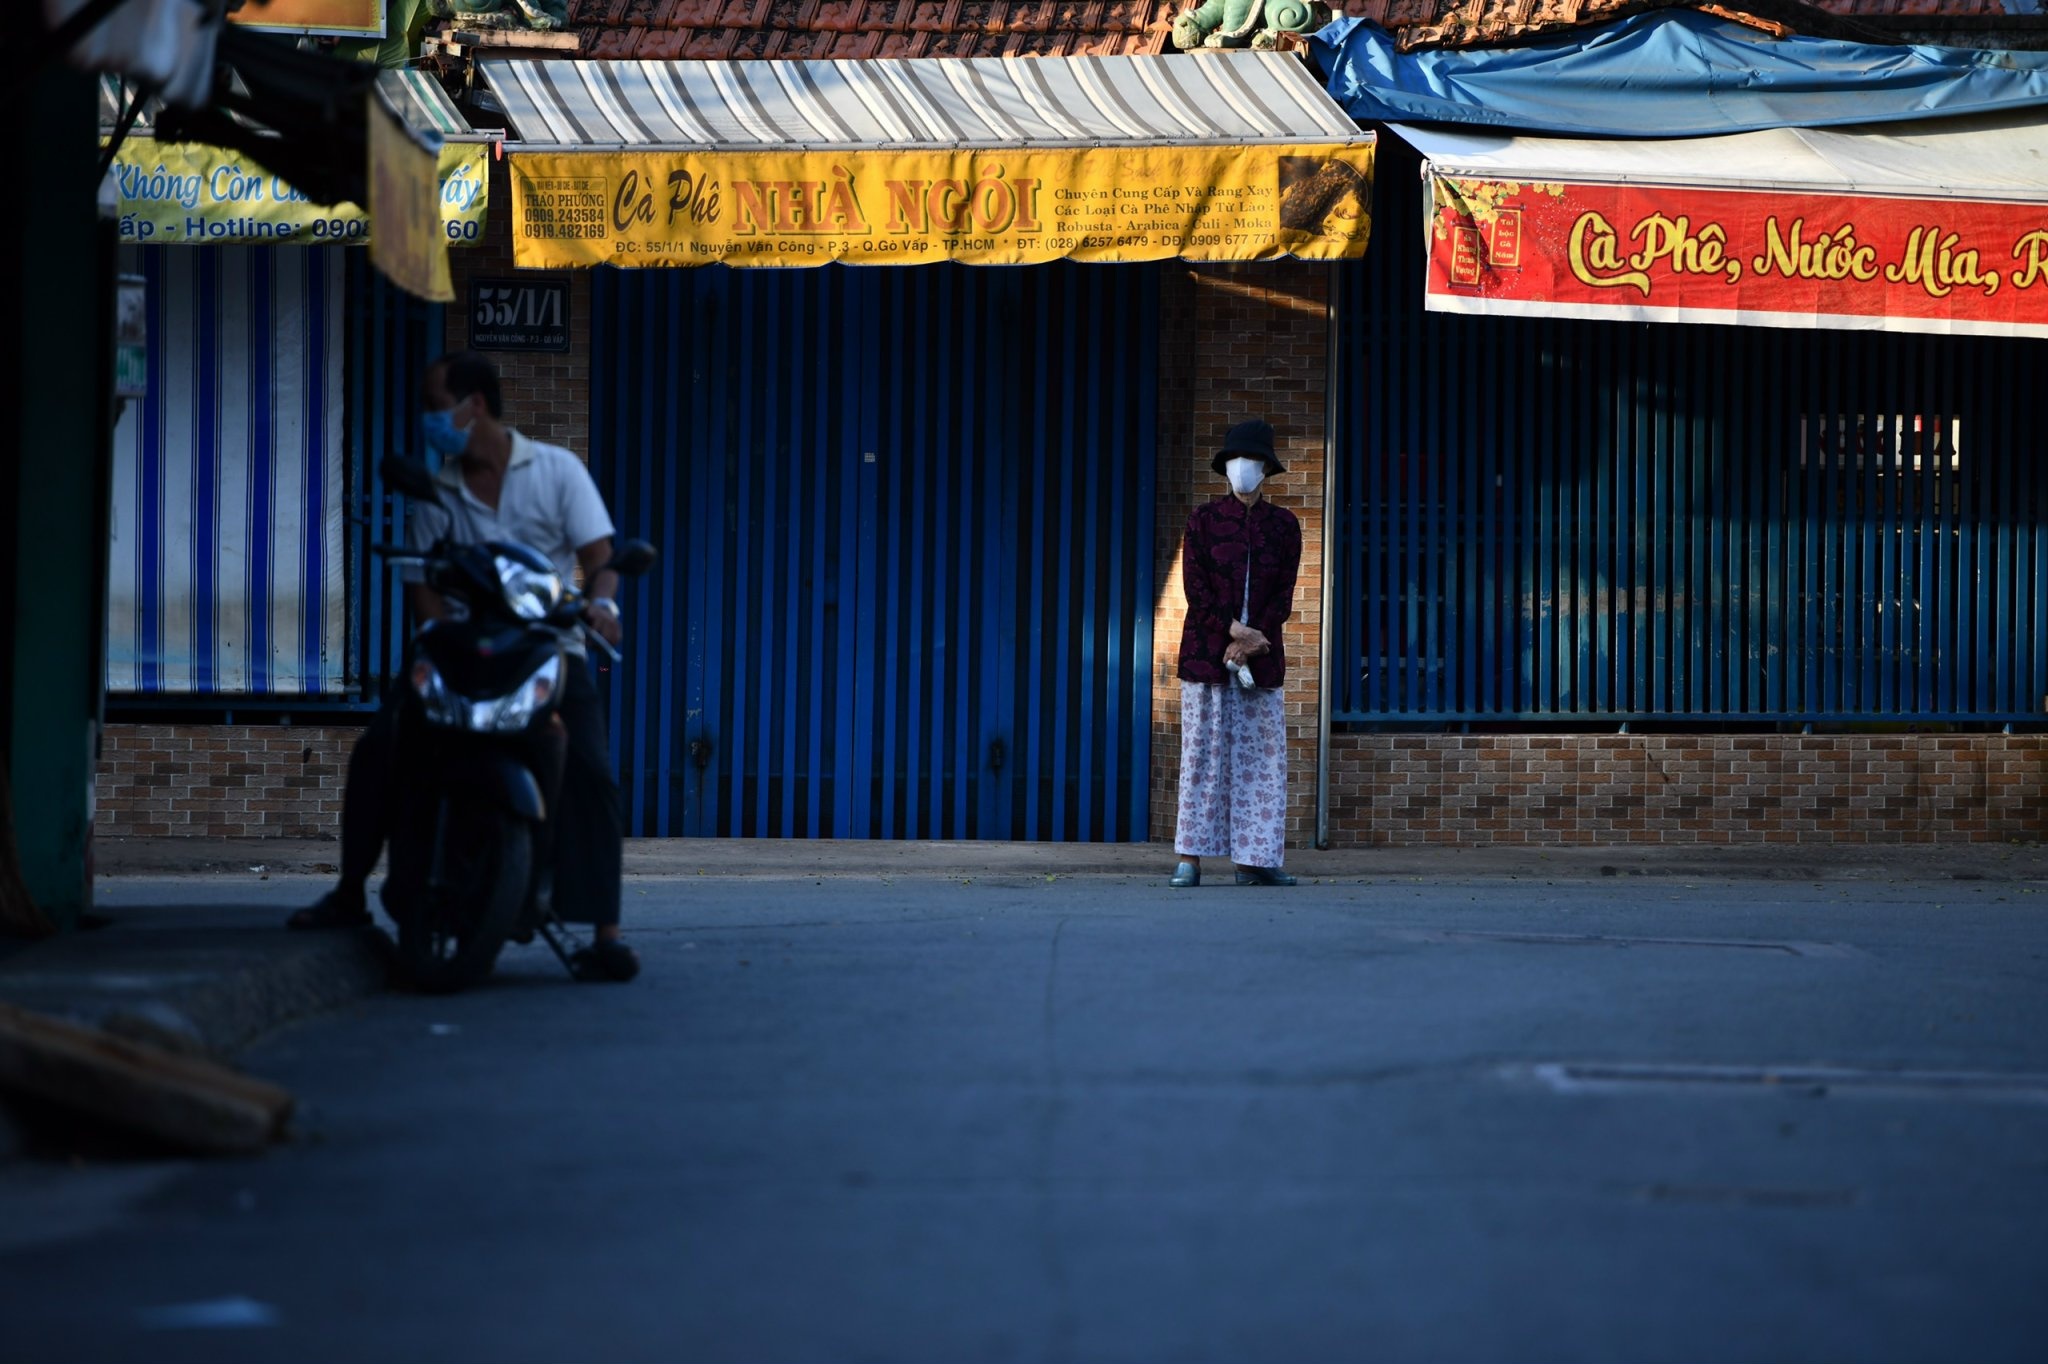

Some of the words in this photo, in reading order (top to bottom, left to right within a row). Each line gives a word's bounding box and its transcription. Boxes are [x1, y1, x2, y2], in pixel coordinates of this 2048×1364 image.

[116, 163, 202, 208] Không
[211, 165, 264, 202] Còn
[1054, 187, 1108, 201] Chuyên
[1112, 188, 1148, 200] Cung
[1153, 184, 1181, 200] Cấp
[1185, 185, 1202, 197] Và
[1207, 185, 1242, 198] Rang
[1247, 185, 1273, 198] Xay
[525, 191, 554, 206] THẢO
[614, 169, 656, 232] Cà
[667, 169, 721, 226] Phê
[731, 165, 870, 234] NHÀ
[885, 163, 1041, 234] NGÓI
[525, 208, 605, 223] 0909.243584
[1055, 204, 1080, 216] Các
[1085, 204, 1116, 217] Loại
[1120, 203, 1139, 214] Cà
[1144, 202, 1170, 213] Phê
[1175, 201, 1211, 216] Nhập
[1215, 201, 1235, 213] Từ
[1239, 200, 1265, 212] Lào
[186, 217, 301, 238] Hotline:
[441, 219, 479, 240] 60
[525, 224, 605, 238] 0919.482169
[1056, 221, 1113, 232] Robusta
[1126, 219, 1180, 231] Arabica
[1192, 218, 1220, 230] Culi
[1233, 217, 1272, 230] Moka
[616, 241, 641, 252] ĐC:
[646, 241, 685, 253] 55/1/1
[690, 238, 742, 255] Nguyễn
[747, 239, 773, 252] Văn
[775, 240, 815, 255] Công
[828, 242, 850, 252] P.3
[863, 240, 898, 252] Q.Gò
[902, 238, 929, 253] Vấp
[942, 239, 995, 250] TP.HCM
[1017, 238, 1041, 250] ĐT:
[1045, 236, 1079, 250] (028)
[1082, 235, 1113, 247] 6257
[1117, 235, 1148, 247] 6479
[1190, 234, 1221, 246] 0909
[1225, 233, 1249, 246] 677
[1253, 233, 1276, 245] 771
[1567, 210, 1650, 298] Cà
[1630, 211, 1742, 285] Phê,
[1752, 215, 1879, 281] Nước
[1885, 226, 2001, 298] Mía,
[477, 287, 564, 327] 55/1/1
